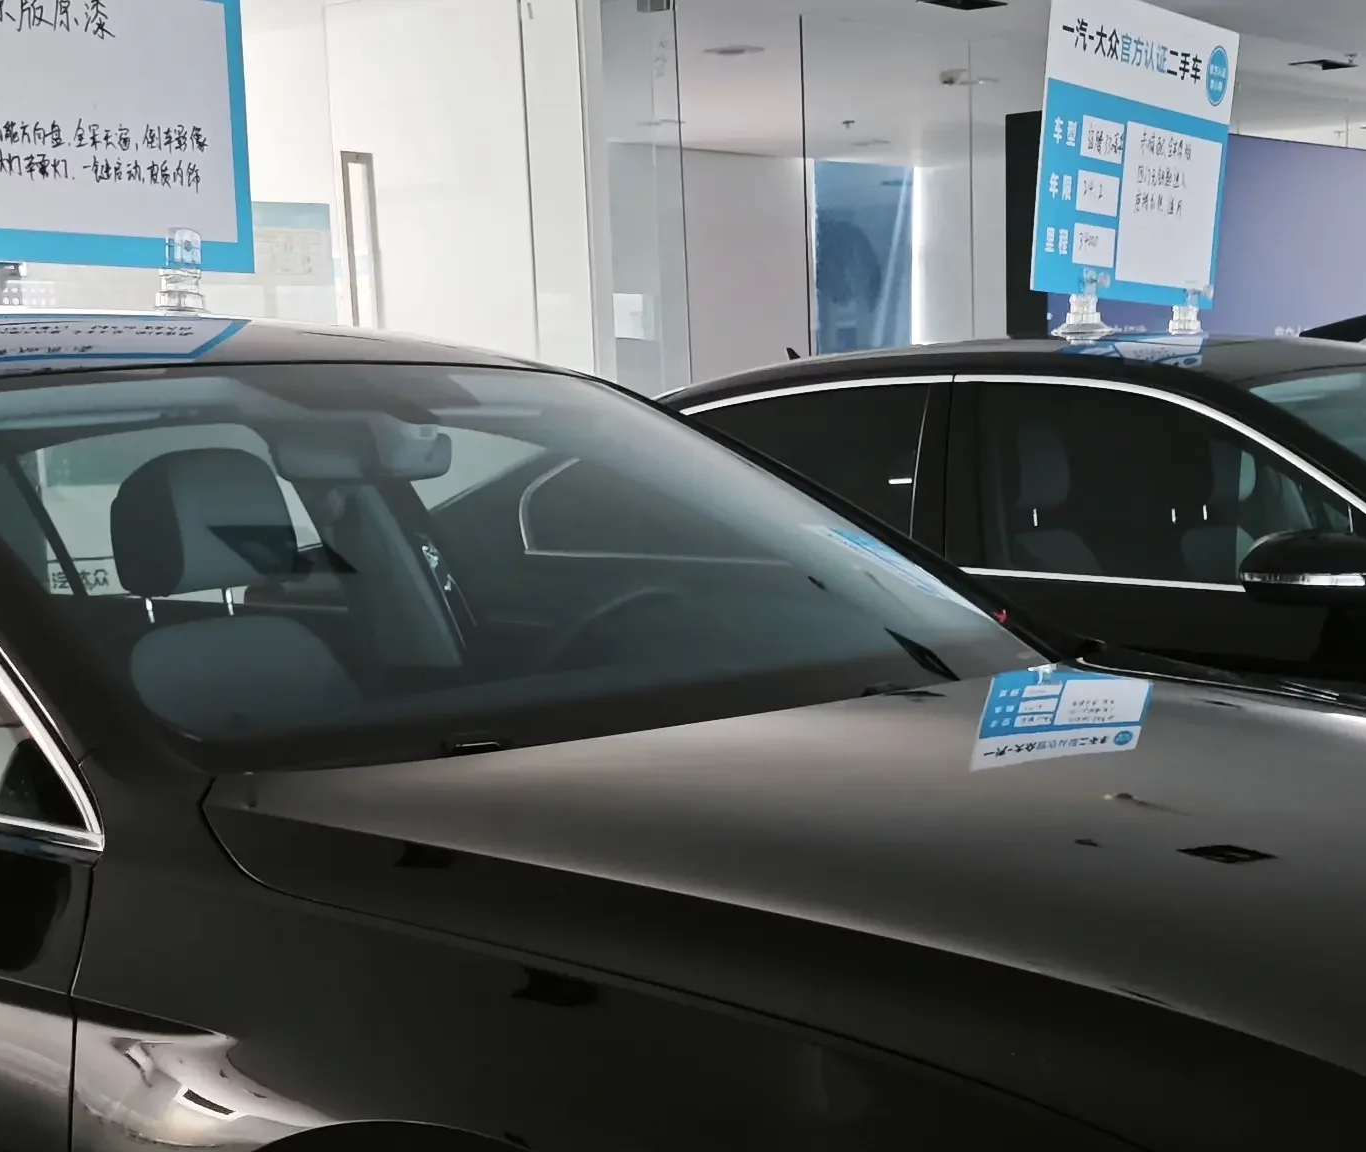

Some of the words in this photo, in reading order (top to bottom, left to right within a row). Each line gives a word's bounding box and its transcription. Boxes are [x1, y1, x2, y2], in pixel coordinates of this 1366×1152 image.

[1062, 18, 1202, 84] 一汽-大众官方认证二手车
